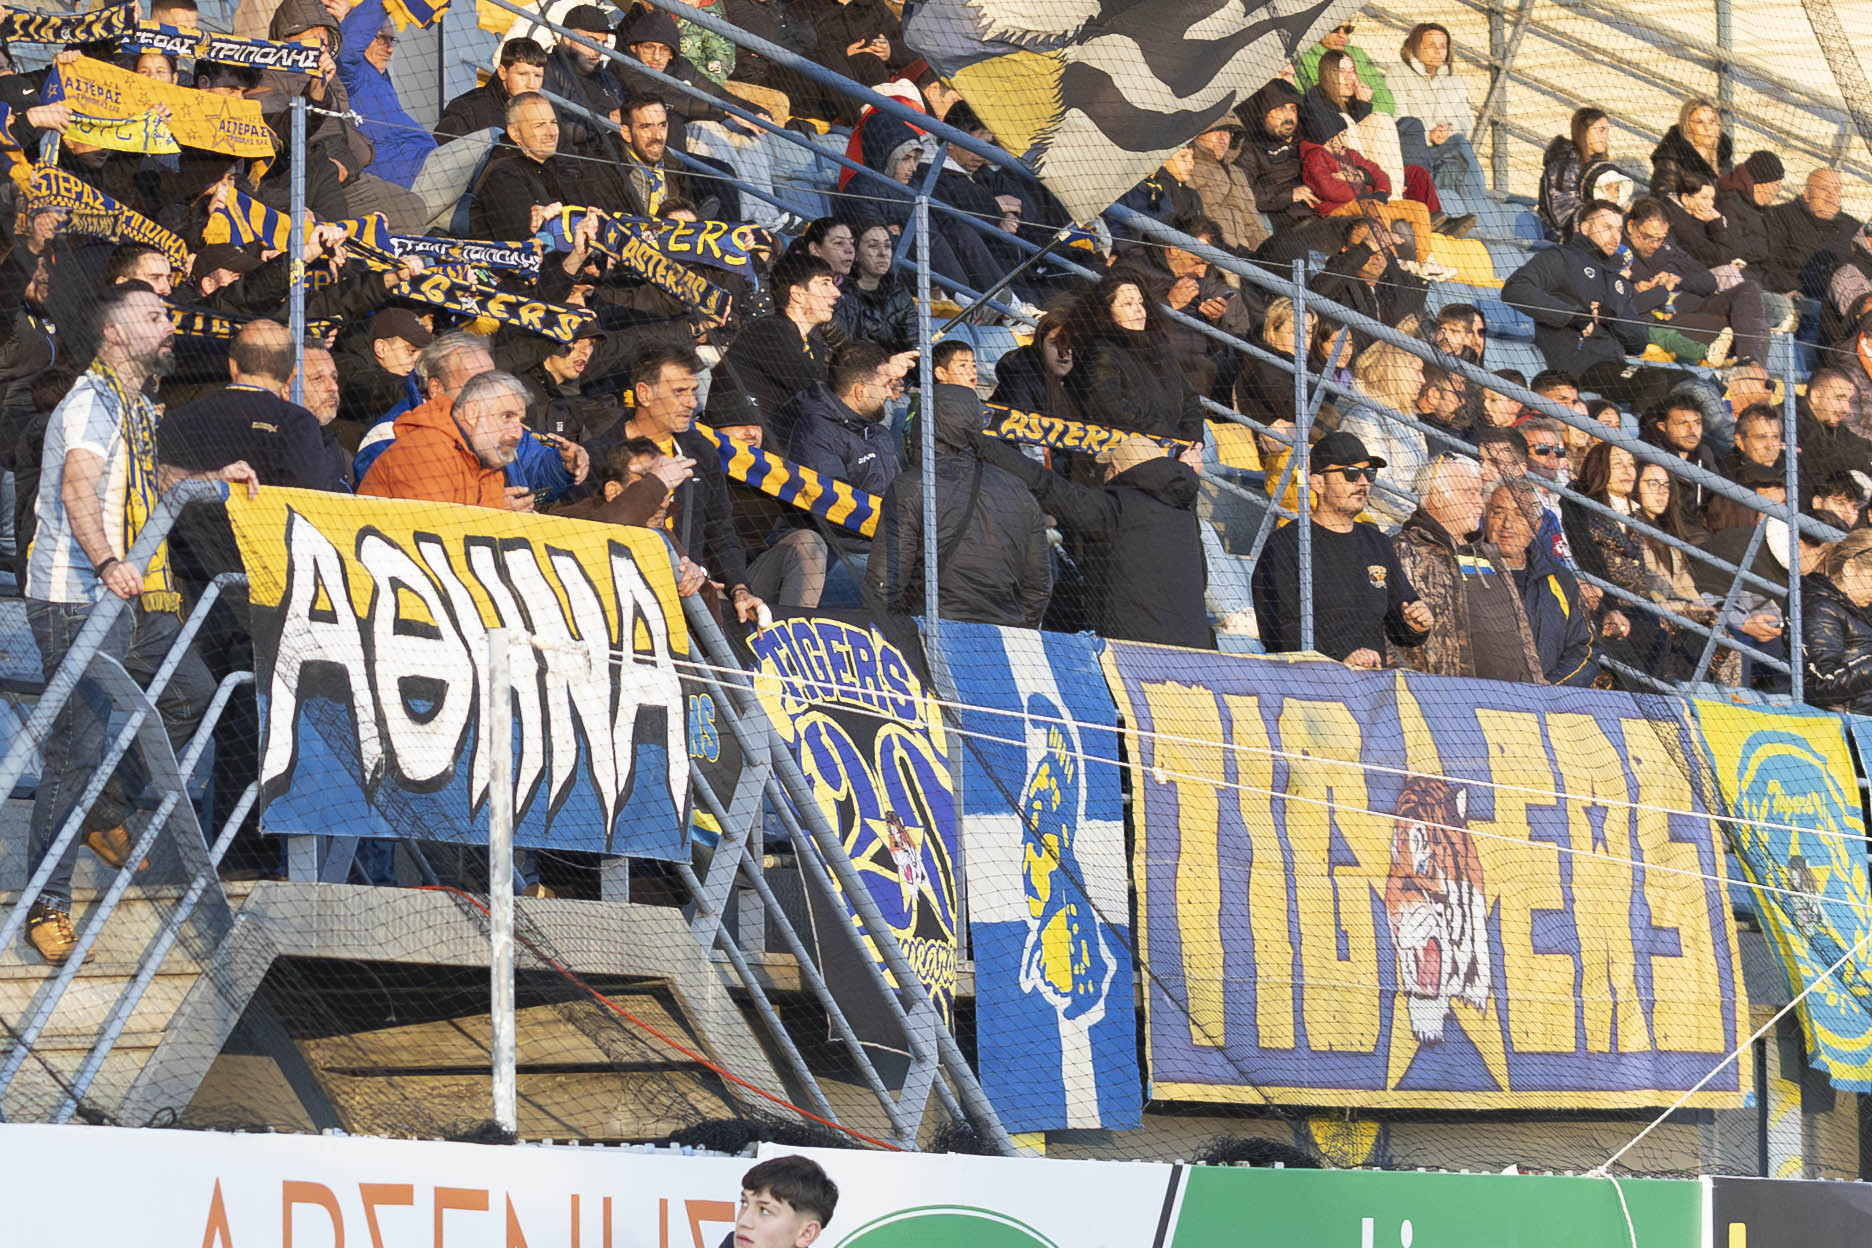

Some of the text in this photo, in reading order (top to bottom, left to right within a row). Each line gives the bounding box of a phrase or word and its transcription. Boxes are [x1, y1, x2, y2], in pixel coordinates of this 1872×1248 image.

[210, 41, 319, 70] ΤΡΙΠΟΛΗΣ
[64, 76, 122, 105] ΑΣΤΕΡΑΣ
[219, 118, 268, 139] ΑΣΤΕΡΑΣ
[750, 618, 925, 731] TIGERS
[1140, 678, 1728, 1054] TIGERS
